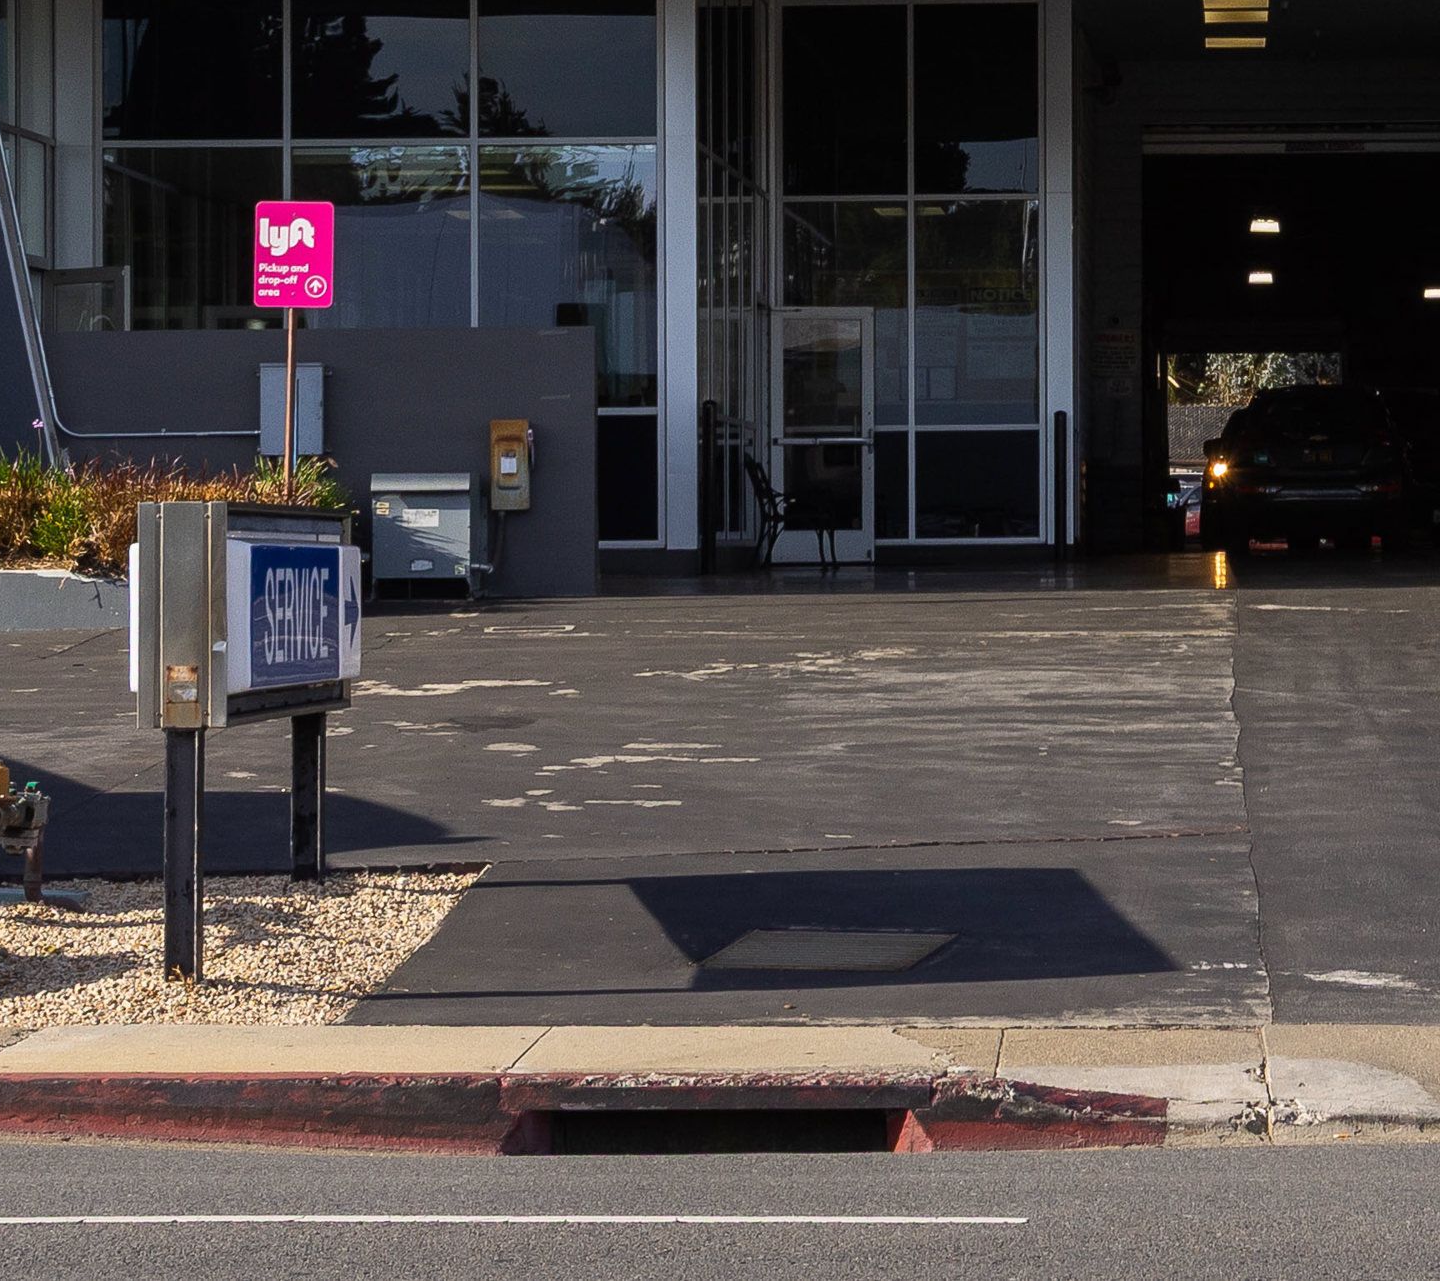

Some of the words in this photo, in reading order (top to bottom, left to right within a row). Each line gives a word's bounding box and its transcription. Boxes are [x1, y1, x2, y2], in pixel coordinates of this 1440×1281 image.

[259, 218, 315, 257] lyft
[258, 263, 289, 274] Pickup
[290, 264, 309, 273] and
[258, 275, 298, 286] drop-off
[970, 288, 1032, 302] NOTICE
[264, 567, 329, 665] SERVICE
